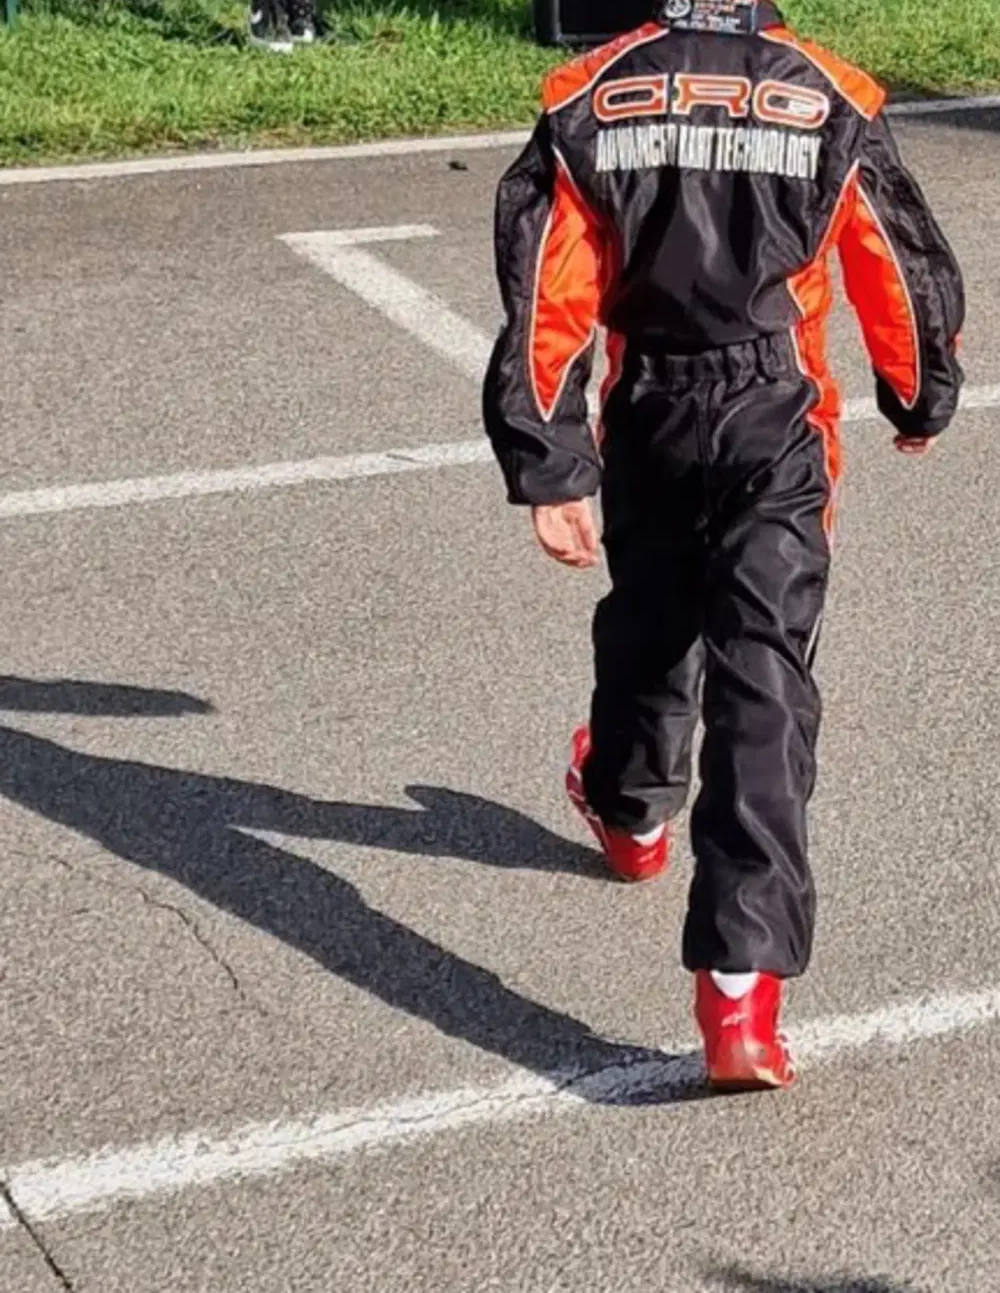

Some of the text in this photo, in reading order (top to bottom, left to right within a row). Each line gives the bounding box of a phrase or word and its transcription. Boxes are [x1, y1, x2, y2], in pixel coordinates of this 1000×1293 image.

[593, 73, 830, 129] CRG
[678, 125, 713, 171] KART
[715, 127, 822, 179] TECHNOLOGY
